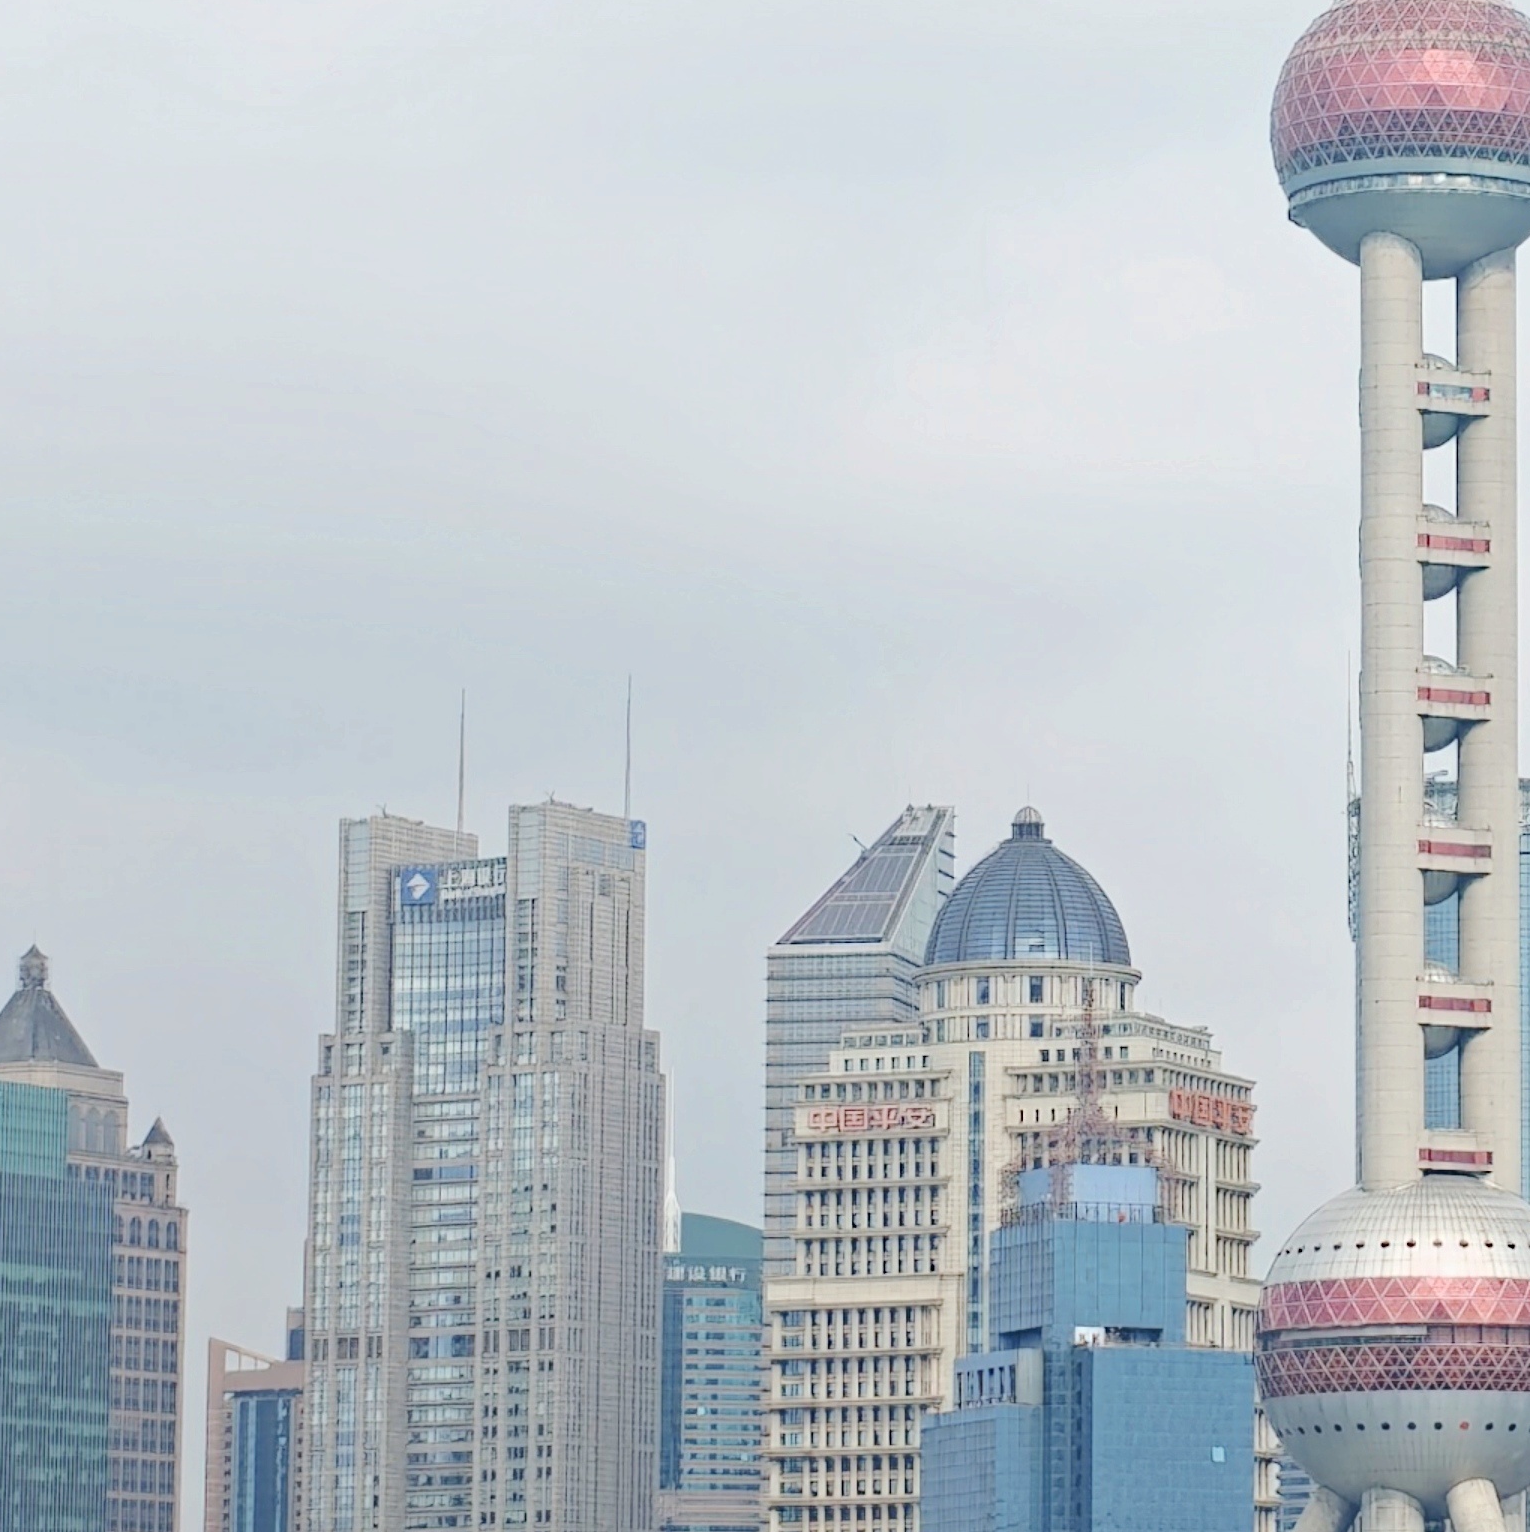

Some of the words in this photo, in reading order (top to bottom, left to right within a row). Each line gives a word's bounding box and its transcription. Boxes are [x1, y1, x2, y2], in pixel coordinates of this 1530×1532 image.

[808, 1103, 936, 1133] 中国平安
[1169, 1086, 1254, 1136] 中国平安
